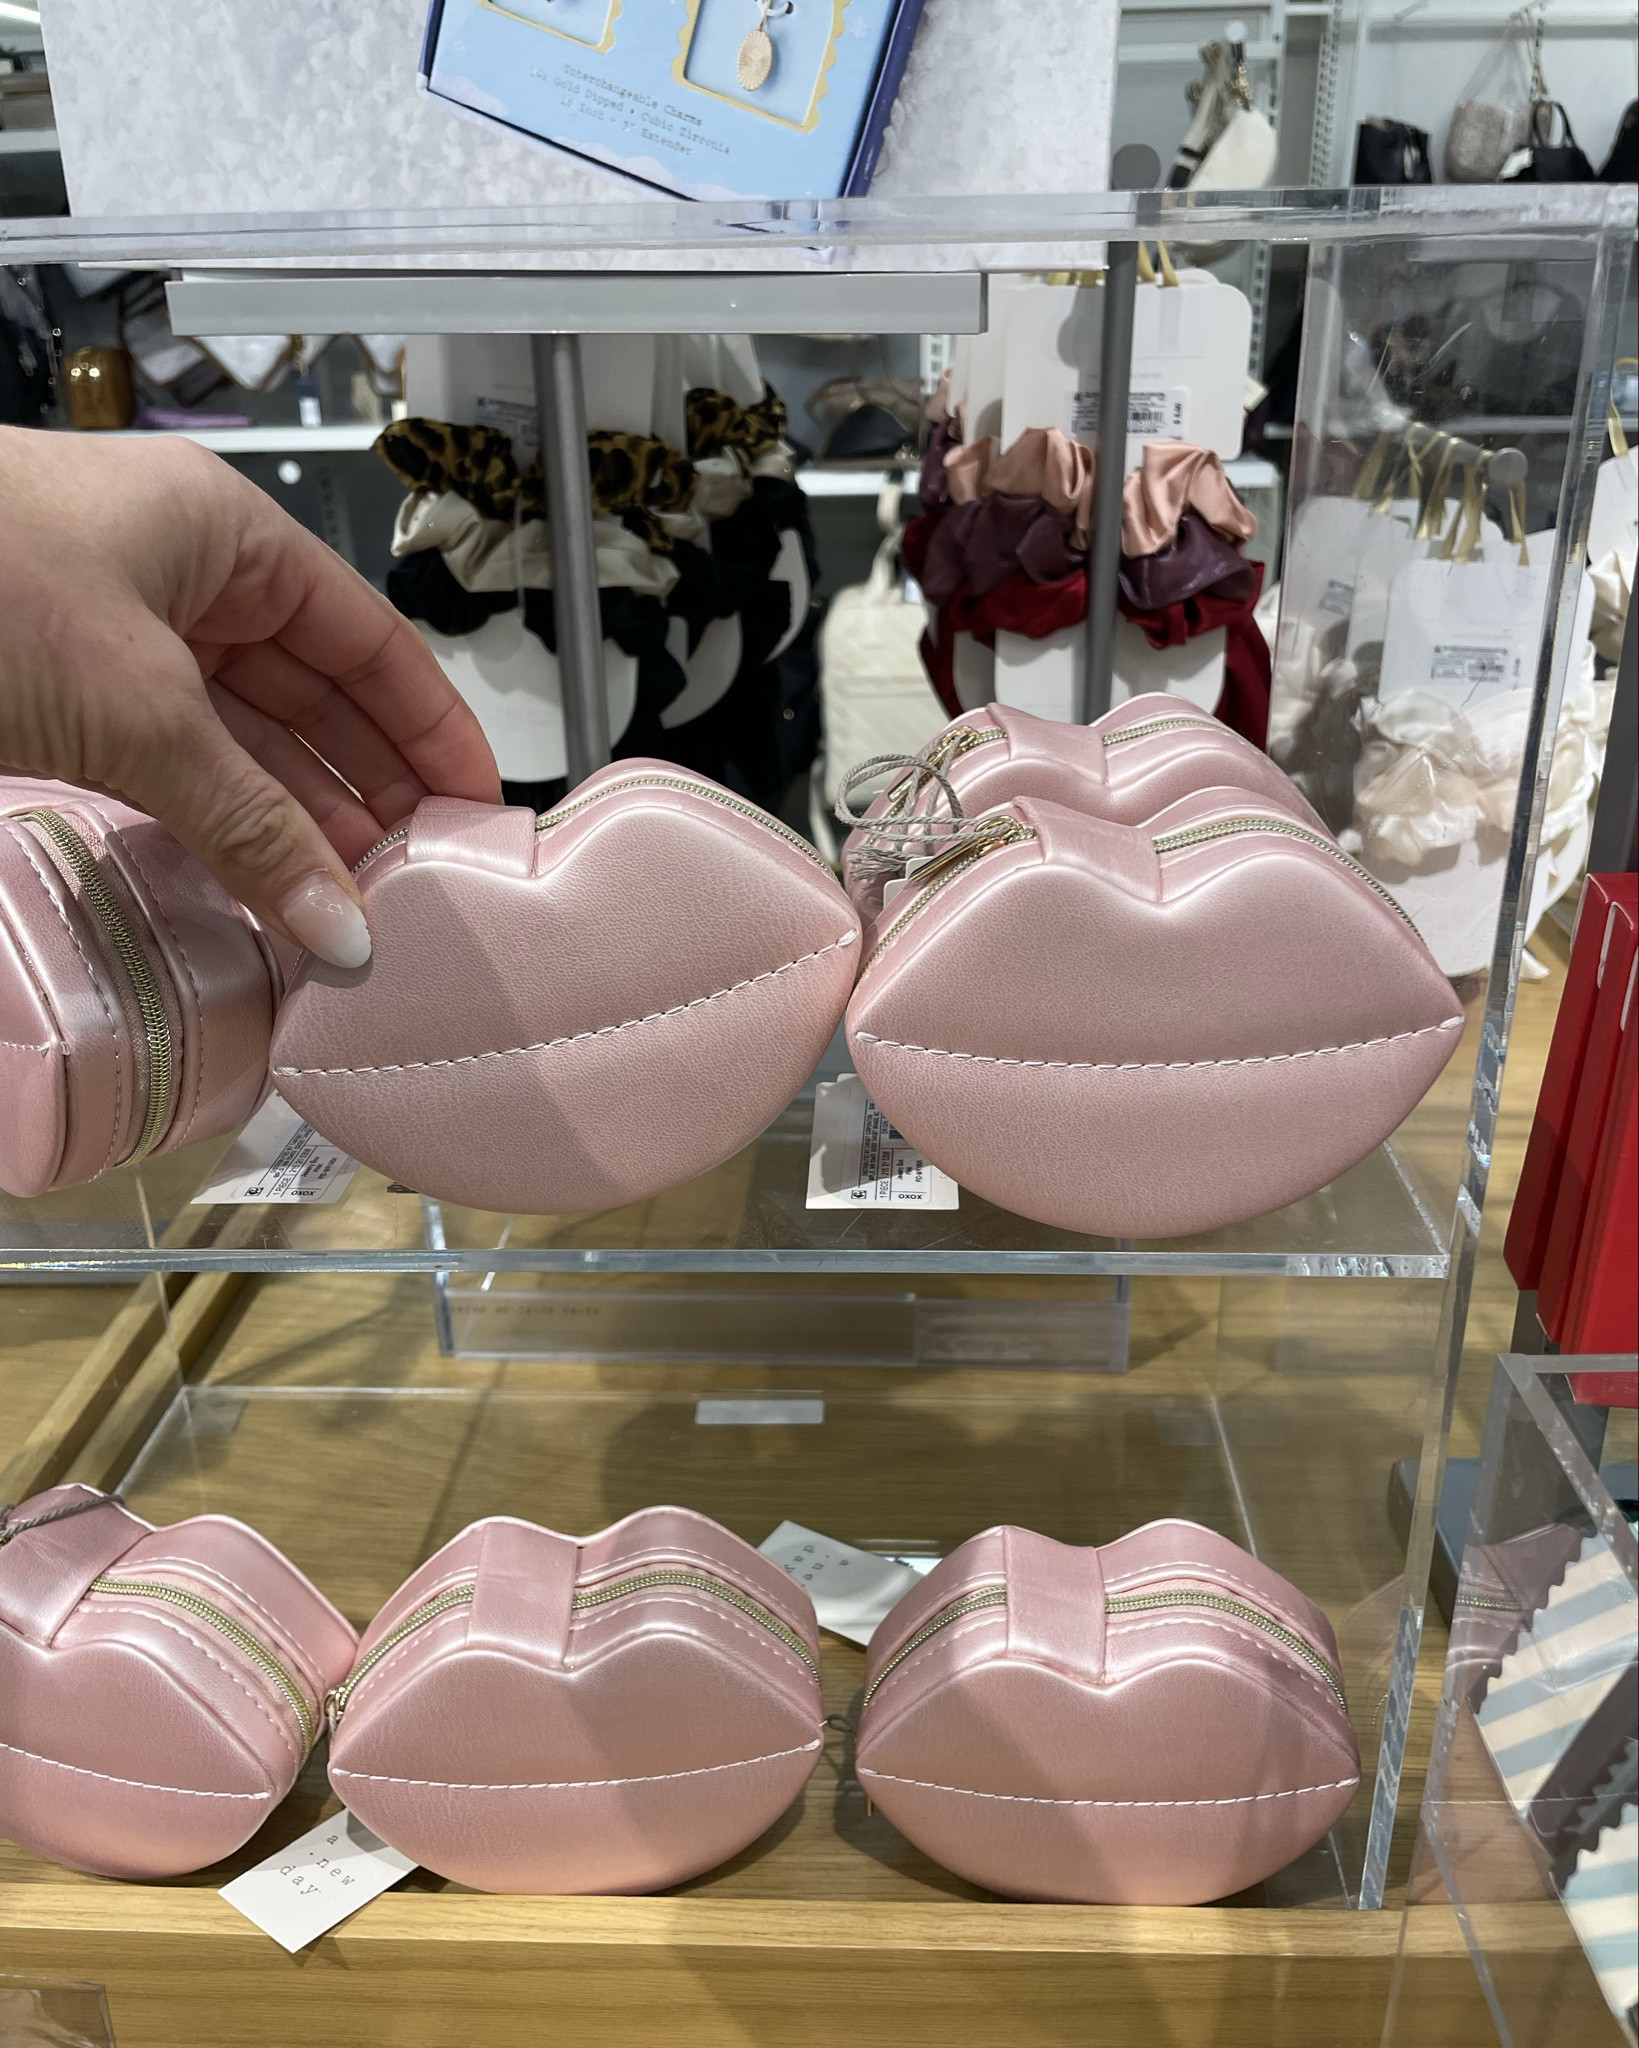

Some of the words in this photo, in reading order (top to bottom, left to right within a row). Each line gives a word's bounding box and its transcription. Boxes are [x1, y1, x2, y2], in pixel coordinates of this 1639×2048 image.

[564, 63, 658, 109] Interchangeable
[664, 104, 703, 127] Charms
[554, 77, 580, 94] Gold
[585, 89, 624, 112] Dipped
[641, 112, 673, 132] Cubic
[679, 127, 730, 155] Zirconia
[641, 128, 694, 156] Extender
[275, 1177, 292, 1192] PIECE
[880, 1180, 889, 1195] PIECE
[326, 1835, 339, 1845] a
[280, 1865, 319, 1895] day
